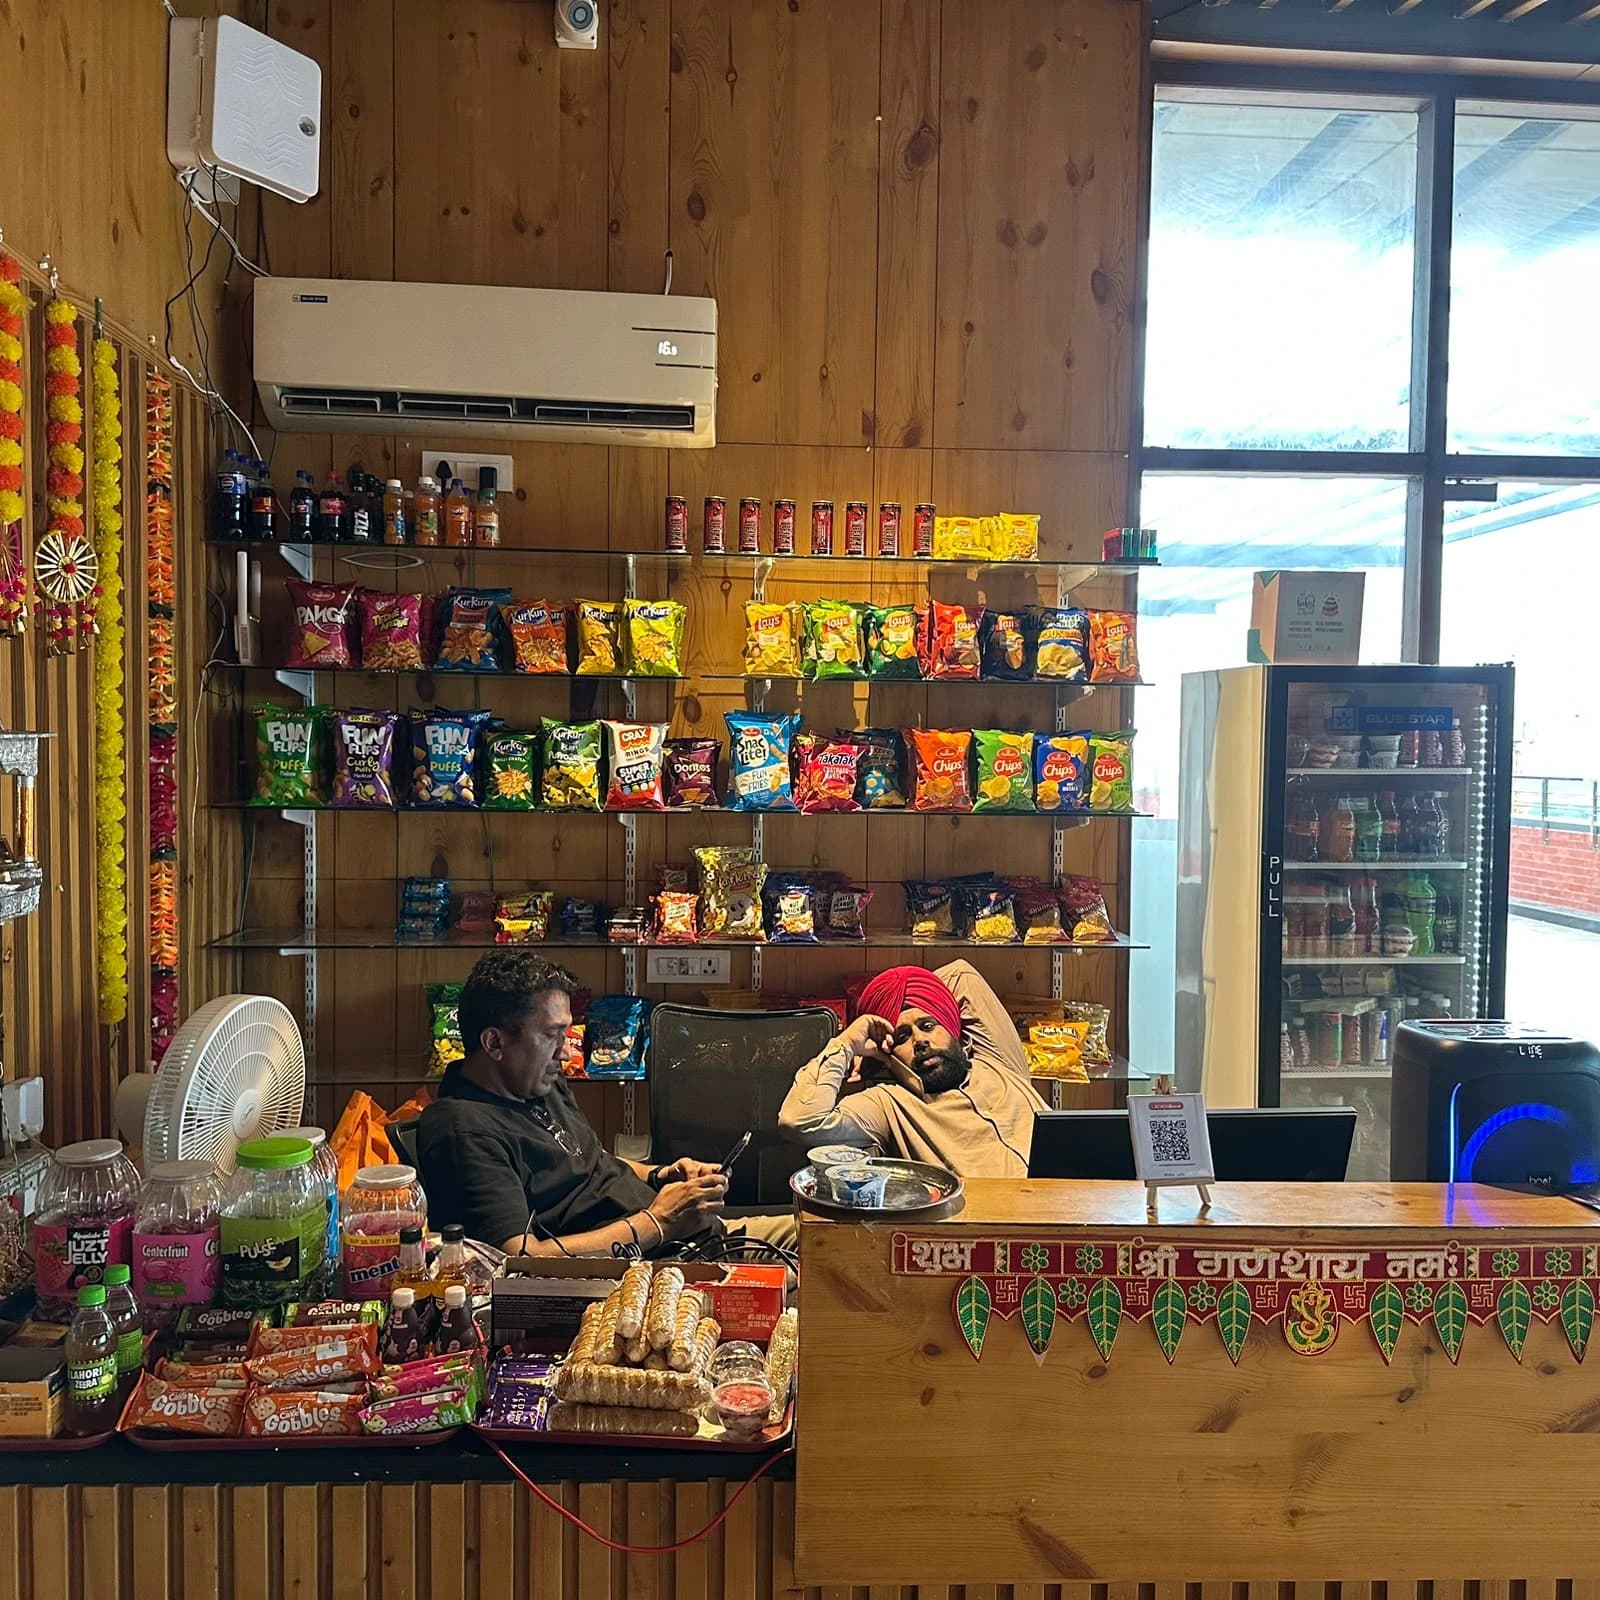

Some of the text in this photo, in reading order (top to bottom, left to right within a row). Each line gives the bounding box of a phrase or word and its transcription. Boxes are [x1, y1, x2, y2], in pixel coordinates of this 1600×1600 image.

[453, 595, 494, 608] Kurkure
[511, 607, 549, 624] Kurkur
[1408, 712, 1447, 725] STAR
[266, 721, 308, 742] FUN
[341, 725, 387, 746] FUN
[425, 725, 470, 744] FUN
[621, 730, 648, 743] CRAX
[626, 748, 650, 757] RINGS
[619, 766, 649, 779] SUPER
[674, 762, 712, 777] Doritos
[751, 770, 768, 781] FUN
[933, 759, 963, 776] Chips
[993, 759, 1024, 776] Chips
[1043, 764, 1074, 781] Chips
[1093, 764, 1123, 781] Chips
[625, 772, 647, 786] CLAY
[748, 780, 769, 793] FRIES
[1267, 856, 1281, 918] PULL
[67, 1239, 110, 1254] JUZT
[142, 1244, 190, 1258] Centerfruit
[239, 1238, 278, 1261] PULSE
[62, 1251, 110, 1266] JELLY
[1135, 1245, 1180, 1279] श्री
[1386, 1249, 1458, 1280] नमः
[350, 1257, 400, 1283] ment
[198, 1310, 253, 1326] Gobbles
[70, 1367, 103, 1381] LAHORI
[152, 1392, 230, 1417] Gobbles
[264, 1406, 342, 1434] Gobbles
